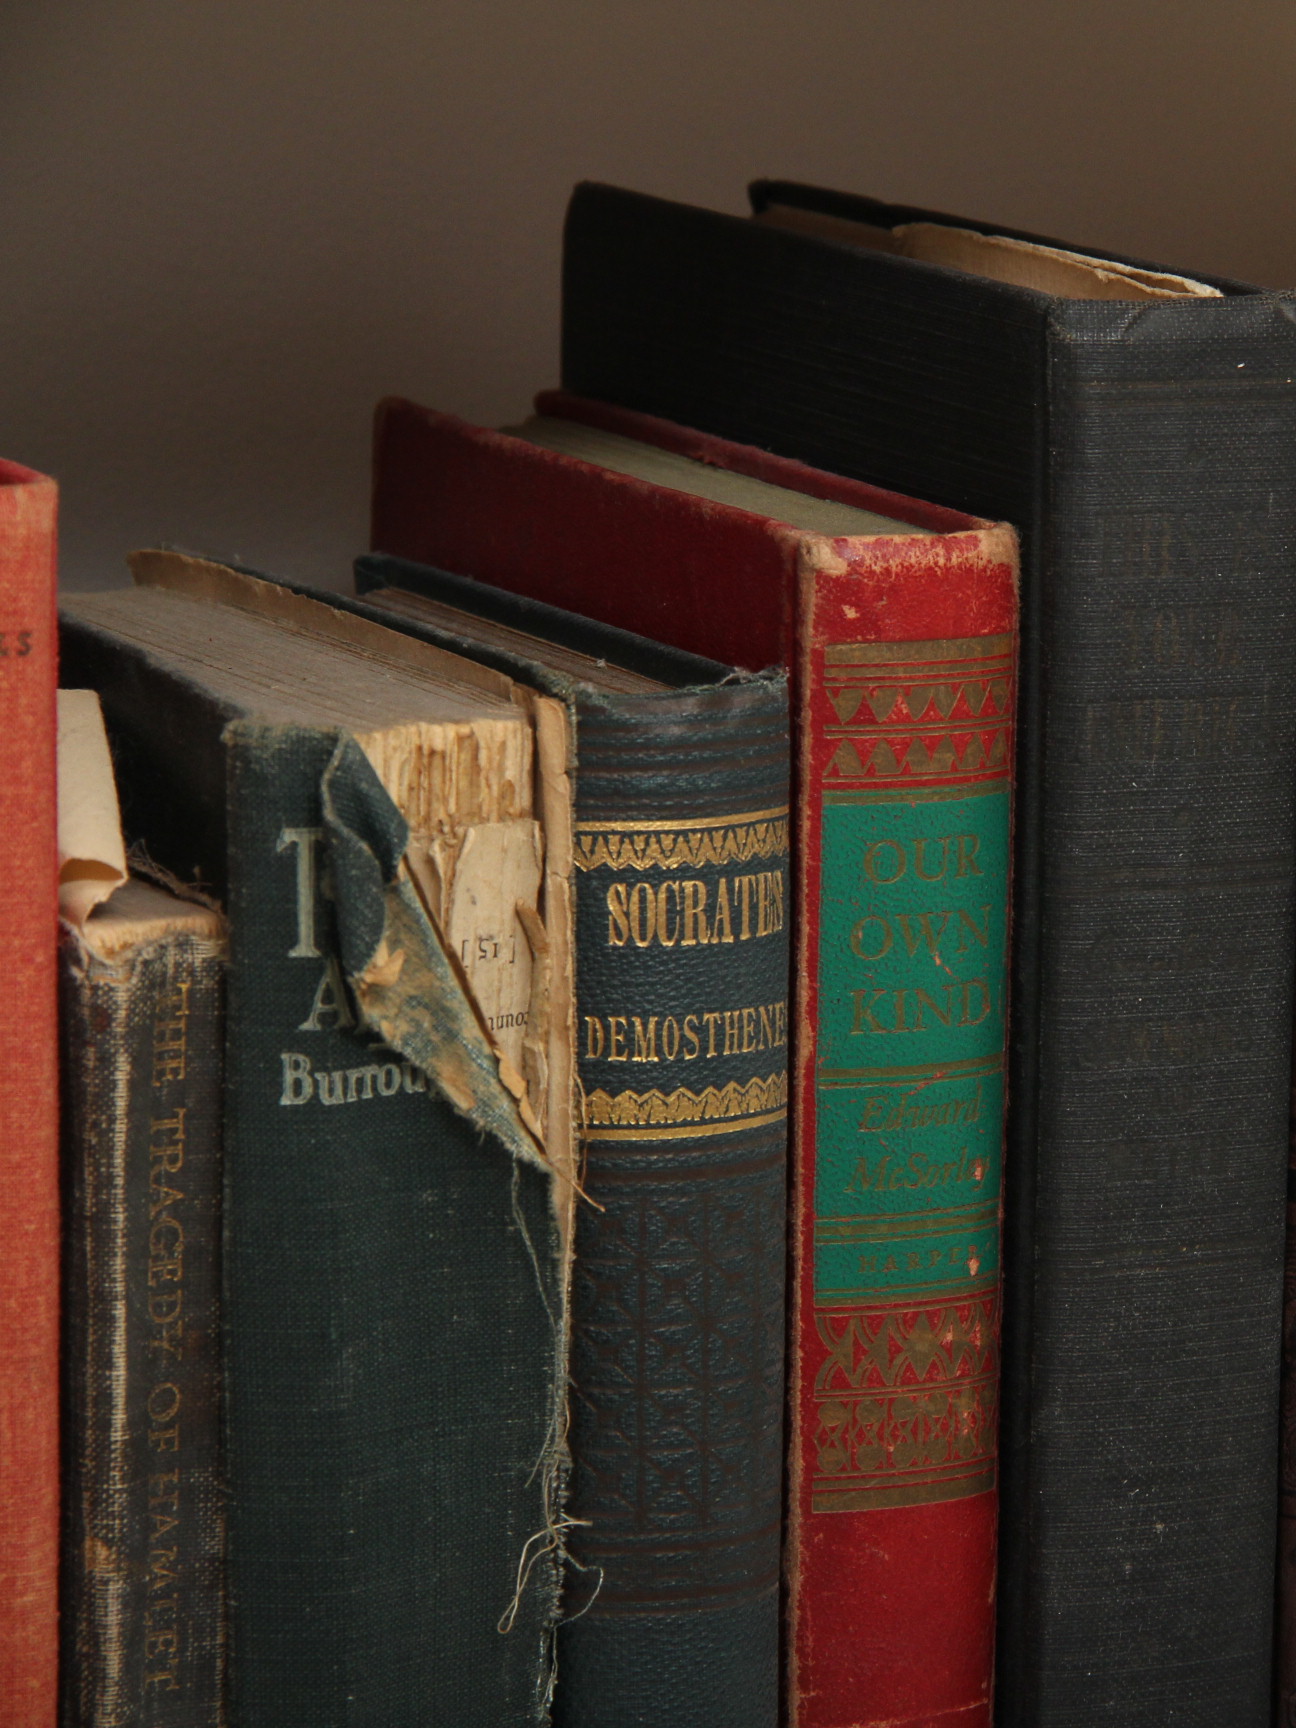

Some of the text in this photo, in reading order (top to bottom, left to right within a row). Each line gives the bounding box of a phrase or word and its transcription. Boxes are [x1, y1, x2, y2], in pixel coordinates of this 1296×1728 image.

[863, 834, 984, 884] OUR
[606, 870, 784, 948] SOCRATES
[849, 905, 992, 959] OWN
[584, 1001, 788, 1063] DEMOSTHENE
[849, 979, 992, 1034] KIND
[152, 982, 191, 1088] THE
[279, 1052, 429, 1106] Burrou
[857, 1084, 984, 1133] Edward
[843, 1147, 990, 1192] McSorley
[148, 1108, 187, 1359] TRAGEDY
[148, 1381, 182, 1454] OF
